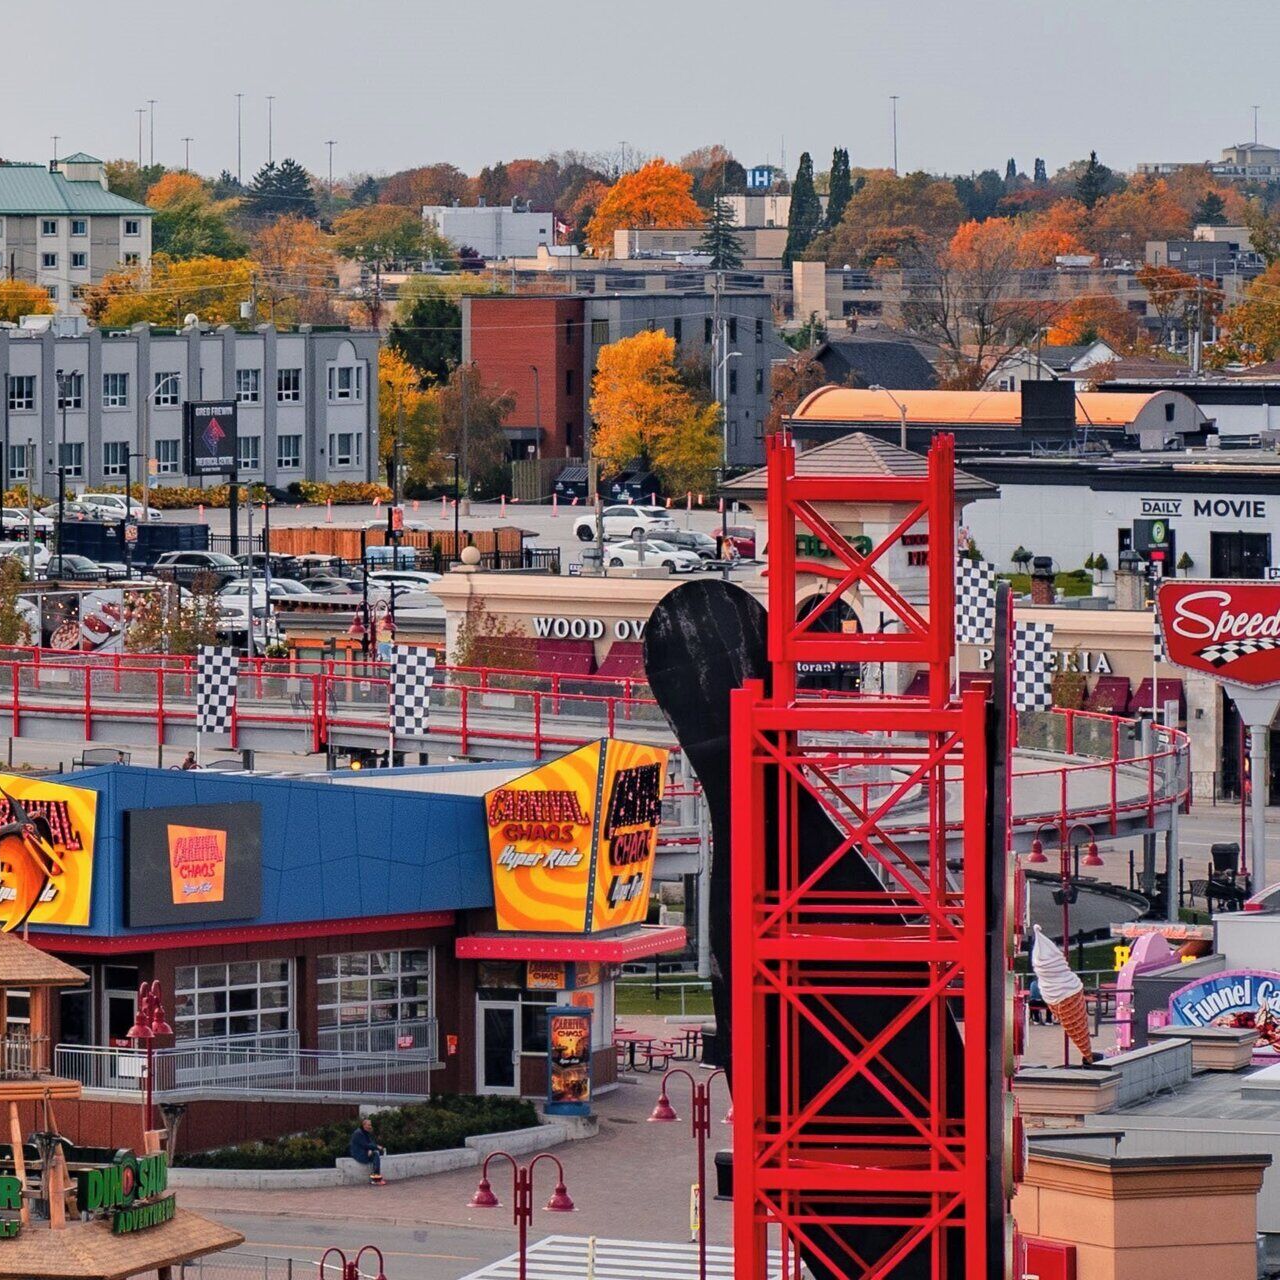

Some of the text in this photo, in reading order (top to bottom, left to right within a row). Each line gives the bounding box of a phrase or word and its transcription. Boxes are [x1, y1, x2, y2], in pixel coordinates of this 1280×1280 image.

[755, 171, 769, 187] H
[1143, 500, 1265, 518] DAILY MOVIE
[533, 618, 604, 638] WOOD
[489, 790, 590, 827] CARNIVAL
[502, 824, 574, 842] CHAOS
[497, 845, 583, 870] Hyper Ride
[180, 863, 215, 878] CHAOS
[1182, 980, 1251, 1027] Funnel
[558, 1030, 584, 1038] CHAOS
